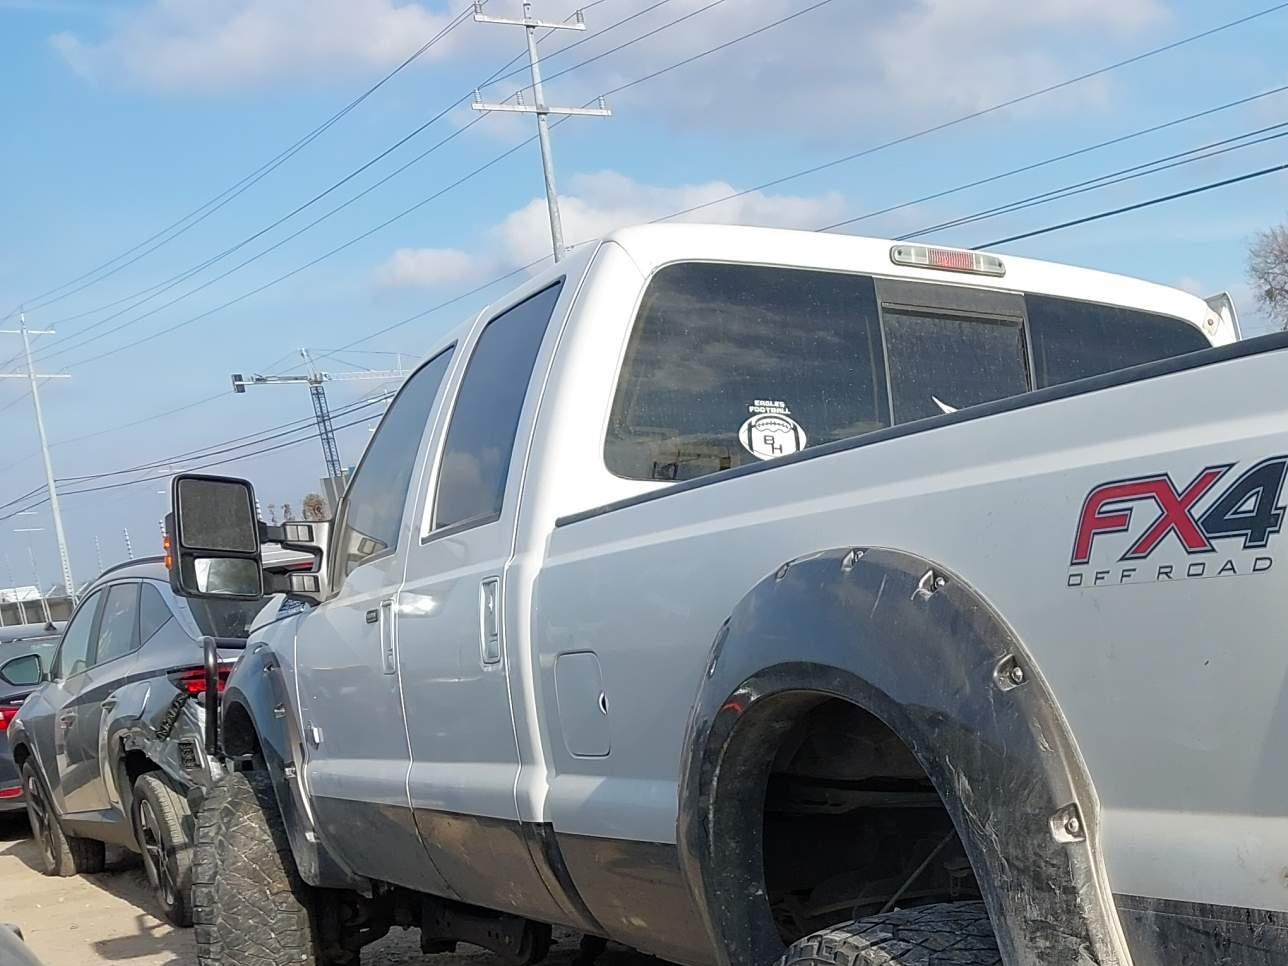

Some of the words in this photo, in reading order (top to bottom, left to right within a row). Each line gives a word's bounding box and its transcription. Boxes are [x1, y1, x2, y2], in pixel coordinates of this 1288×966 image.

[749, 406, 791, 414] FOOTBALL
[1067, 568, 1136, 587] OFF
[1156, 557, 1273, 580] ROAD
